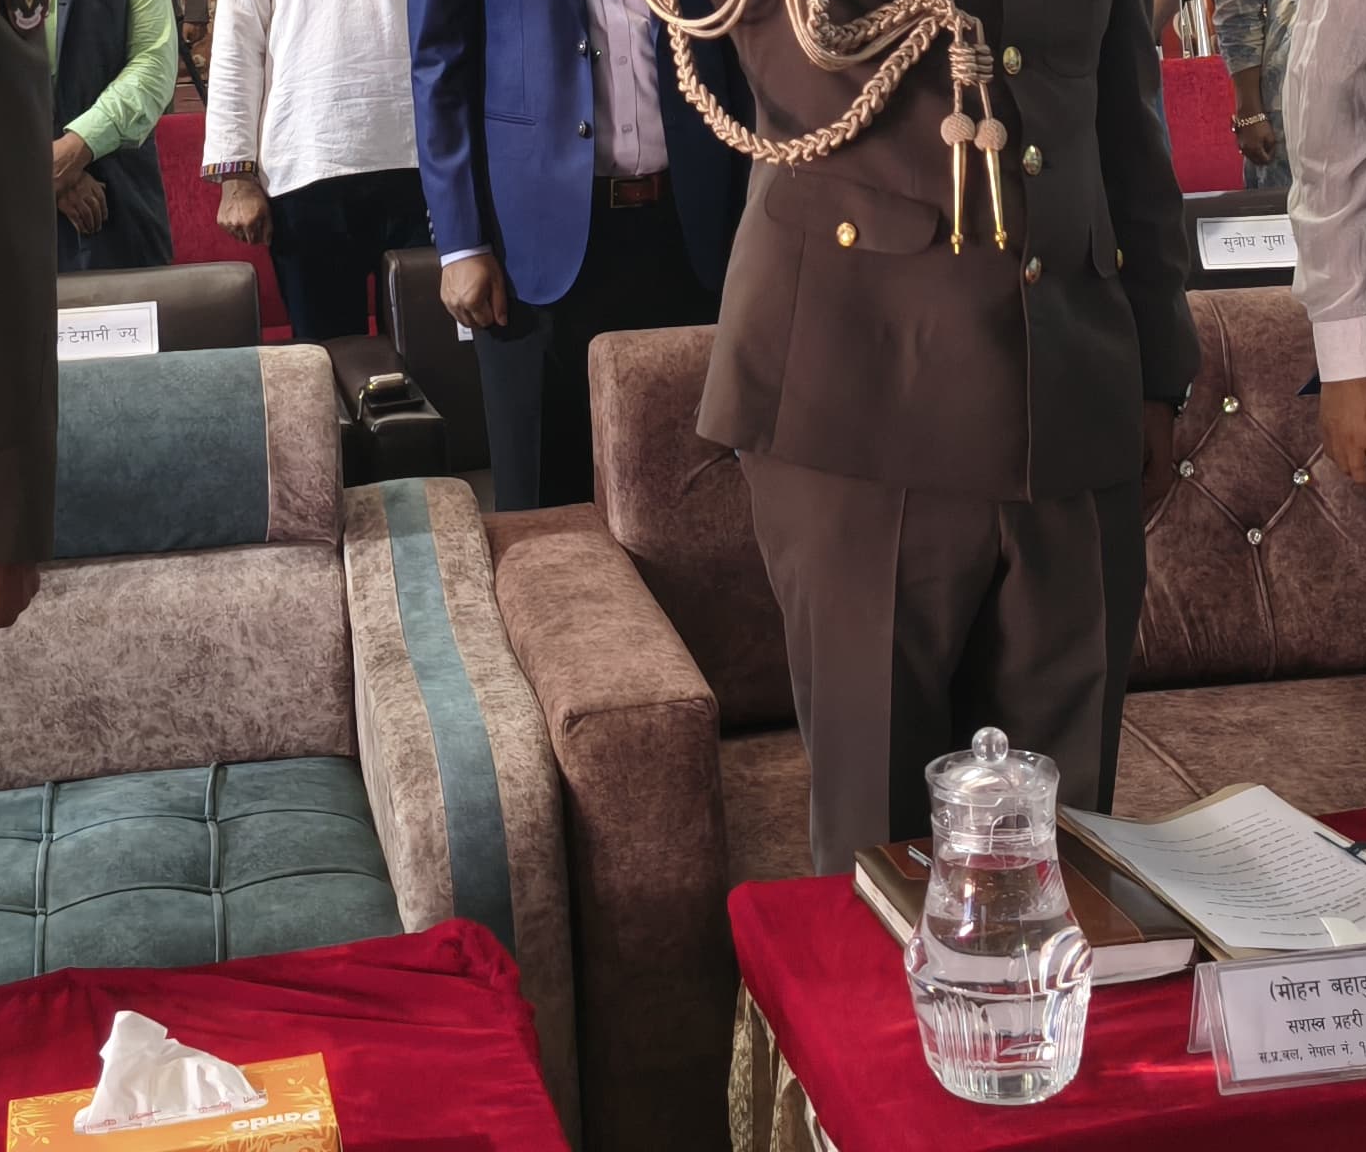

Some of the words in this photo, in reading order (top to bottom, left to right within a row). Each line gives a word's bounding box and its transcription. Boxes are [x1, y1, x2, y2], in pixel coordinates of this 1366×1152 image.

[117, 327, 140, 343] ज्यू
[1270, 976, 1321, 1002] (मोहन
[1333, 1009, 1364, 1029] प्रहरी
[1308, 1043, 1336, 1059] नेपाल
[231, 1110, 321, 1130] Panda
